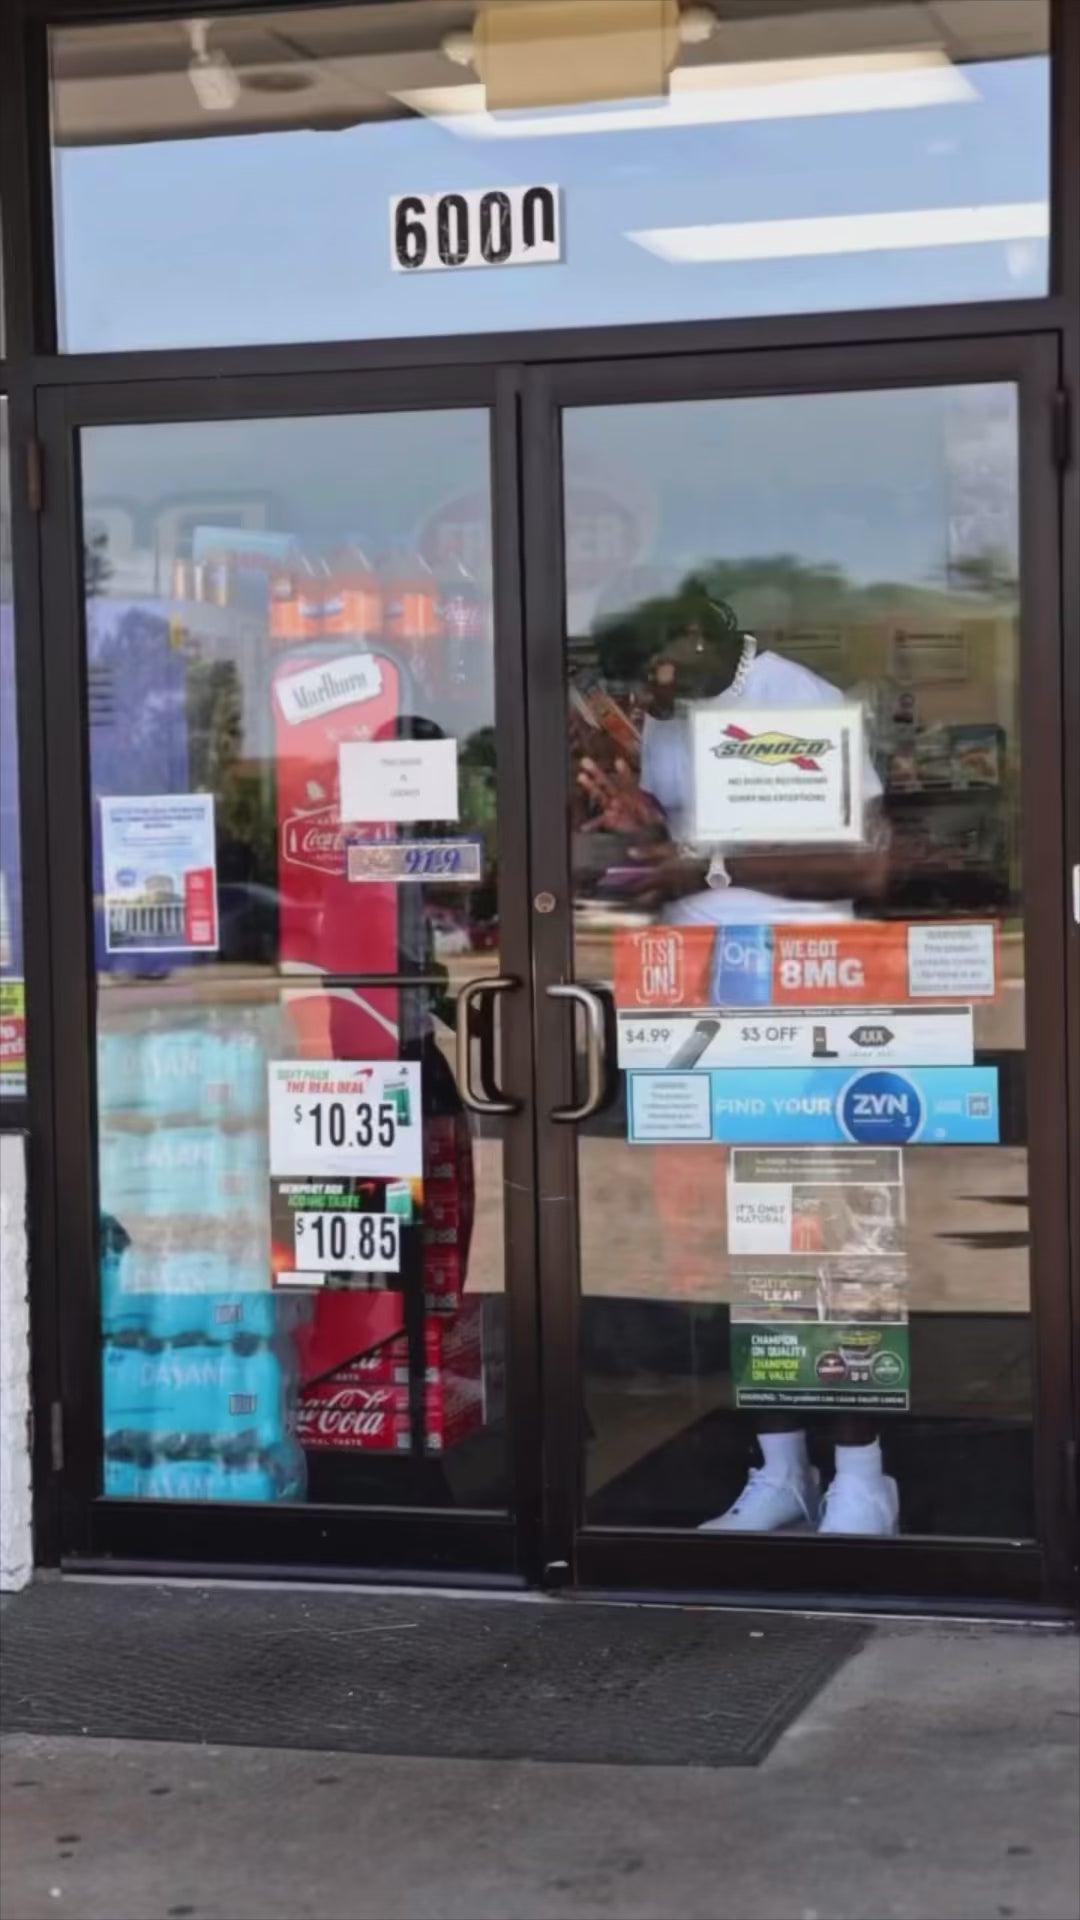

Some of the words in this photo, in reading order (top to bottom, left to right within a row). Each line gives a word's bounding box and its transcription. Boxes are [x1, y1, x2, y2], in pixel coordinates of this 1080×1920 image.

[396, 187, 554, 268] 6000
[721, 742, 824, 756] SUNOCO
[806, 940, 839, 957] GOT
[780, 959, 865, 989] 8MG
[287, 1080, 304, 1094] THE
[308, 1080, 335, 1094] REAL
[336, 1080, 364, 1094] DEAL
[716, 1098, 766, 1116] FIND
[773, 1097, 832, 1115] YOUR
[852, 1093, 908, 1115] ZYN
[752, 1335, 798, 1345] CHAMPION
